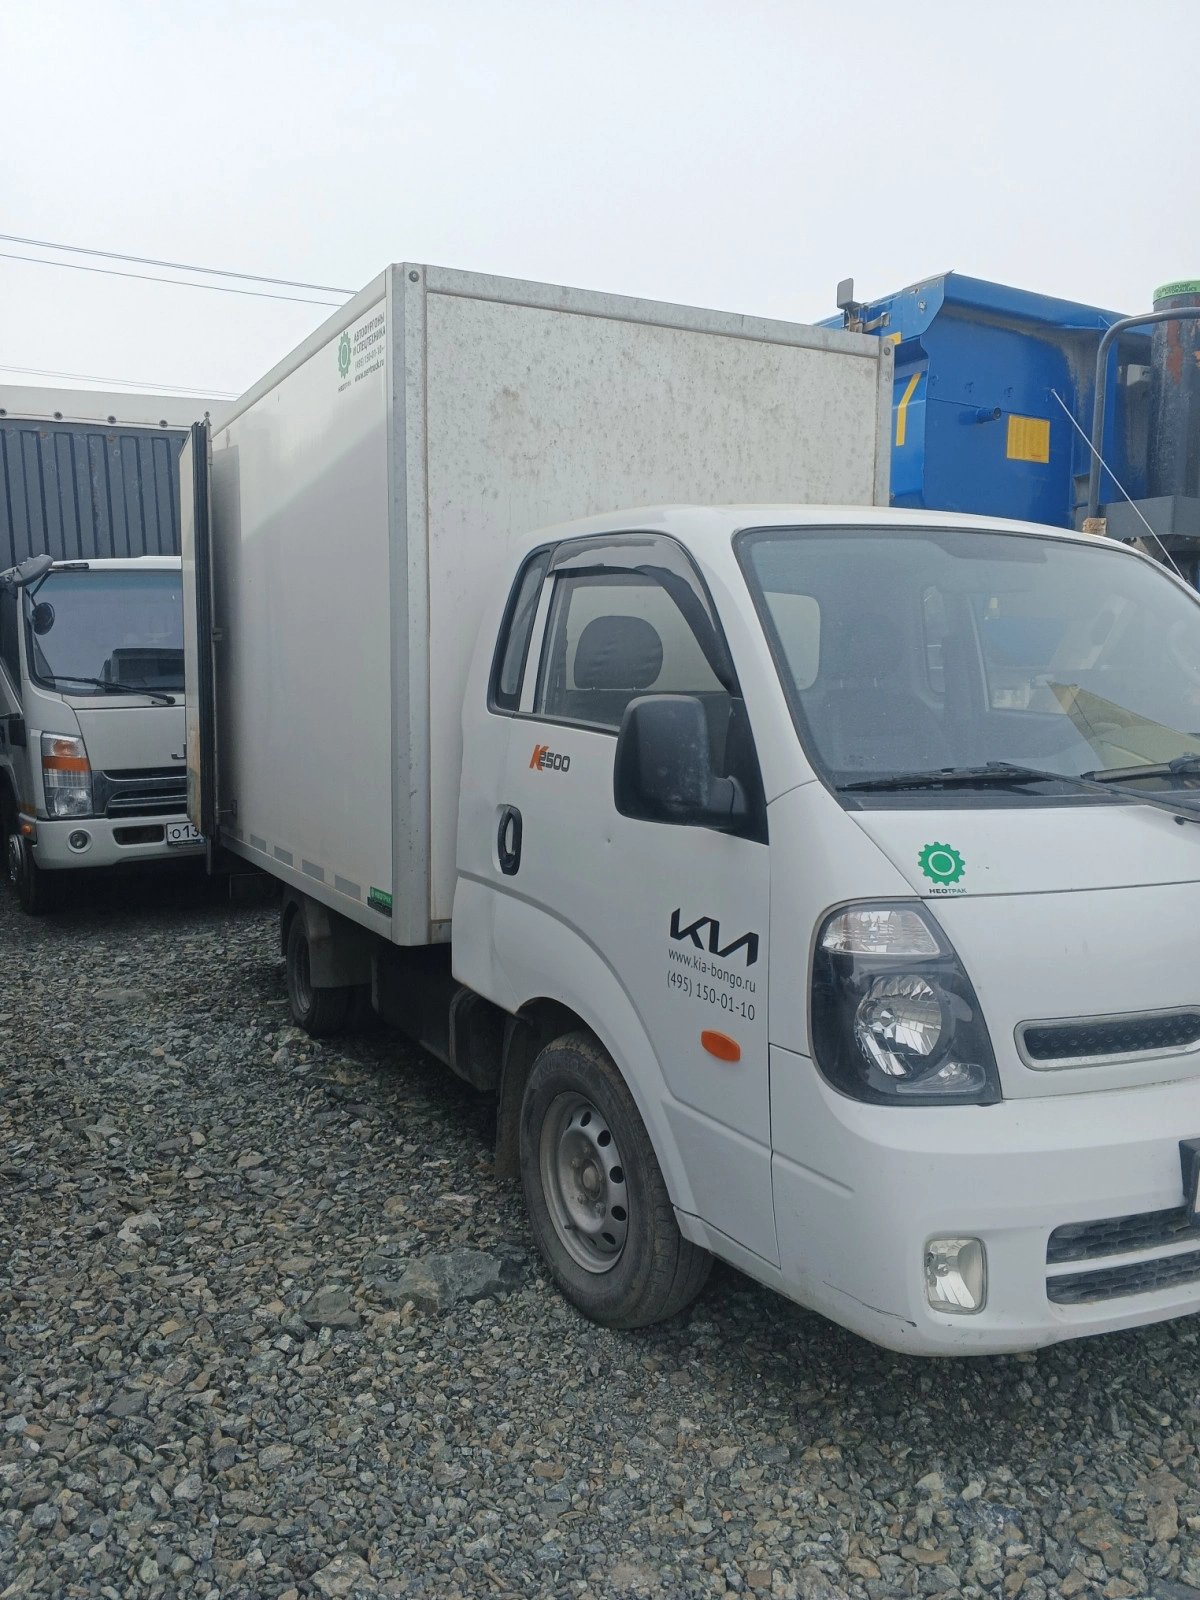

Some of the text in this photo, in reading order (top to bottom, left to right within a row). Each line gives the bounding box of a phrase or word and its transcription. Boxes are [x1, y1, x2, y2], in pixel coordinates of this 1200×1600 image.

[357, 326, 385, 353] СПЕЦТЕХНИКА
[529, 744, 571, 772] K2500
[670, 908, 759, 967] KIA
[668, 948, 756, 993] www.kia-bongo.ru
[667, 970, 756, 1021] (495) 150-01-10
